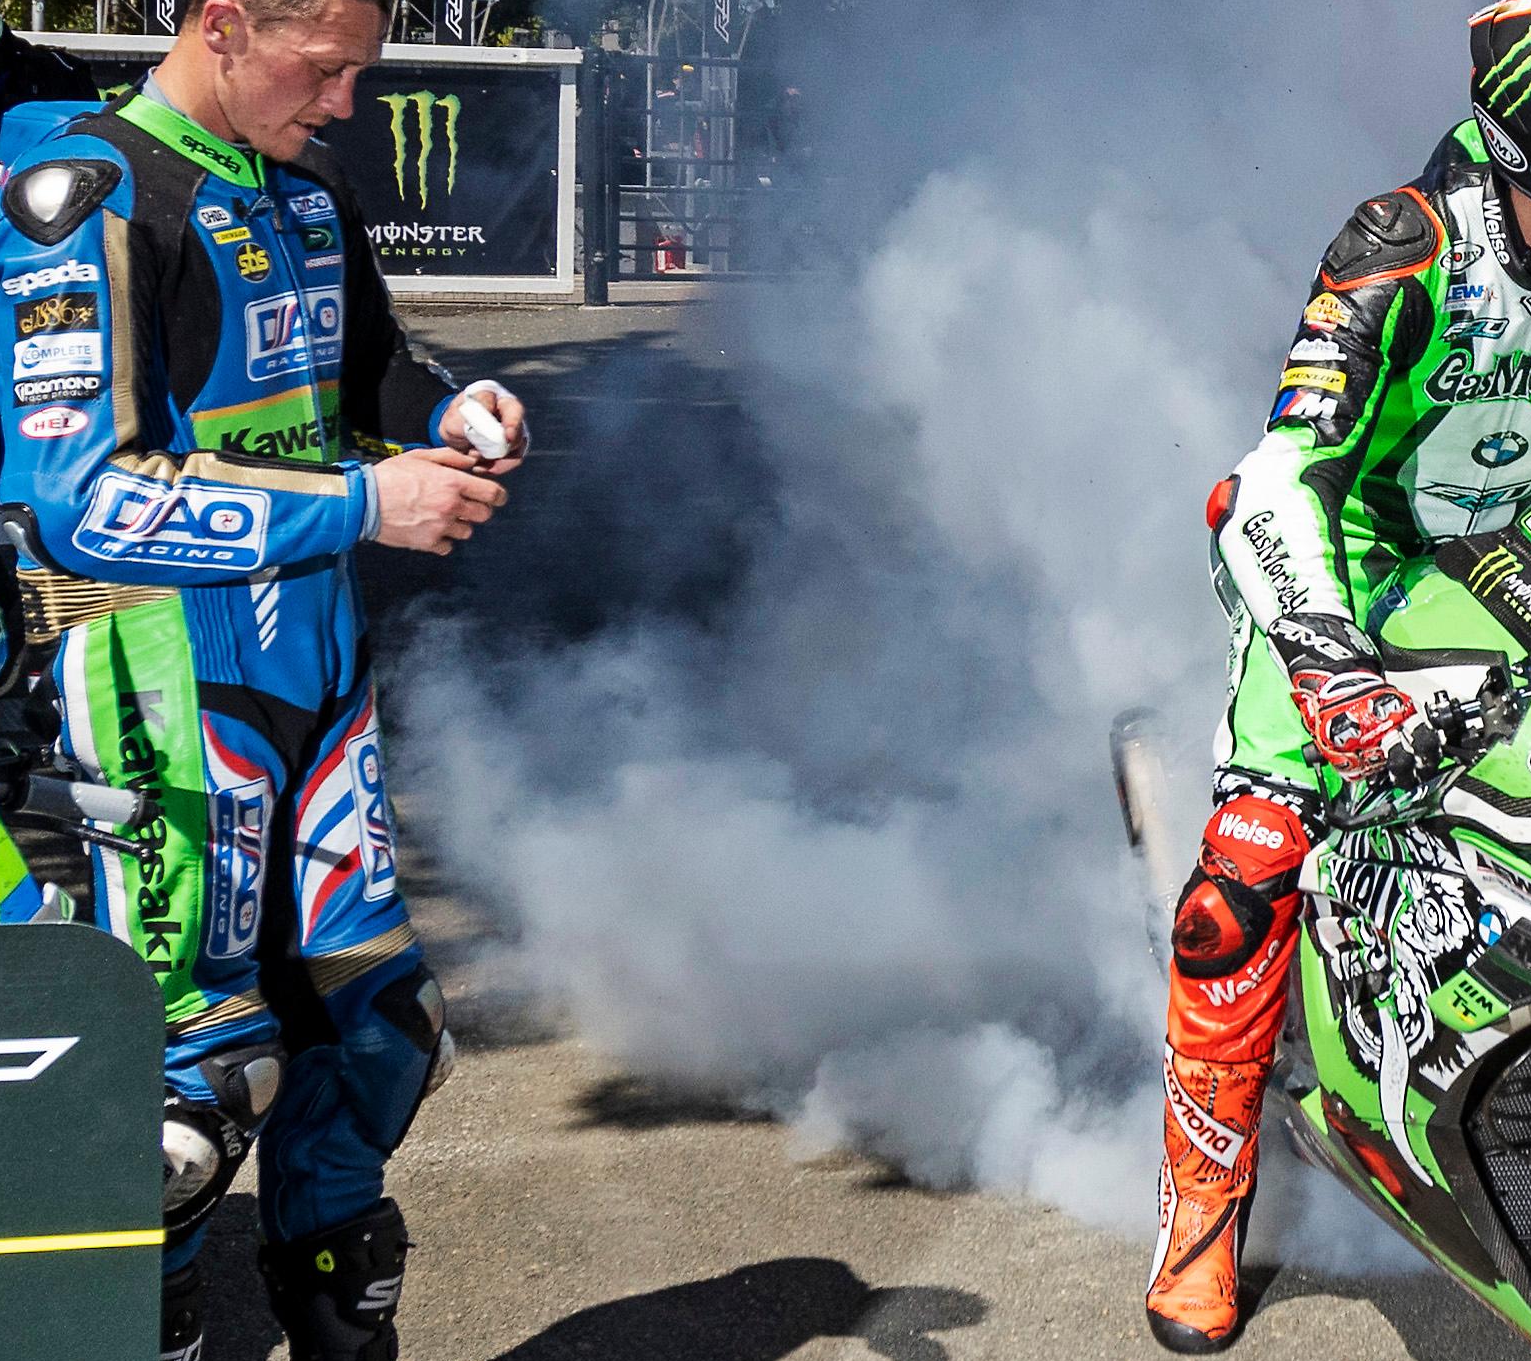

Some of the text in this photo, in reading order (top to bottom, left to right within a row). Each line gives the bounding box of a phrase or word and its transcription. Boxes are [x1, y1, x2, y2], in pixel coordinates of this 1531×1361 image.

[181, 133, 243, 176] spada
[363, 220, 486, 246] MONSTER
[1483, 196, 1511, 265] Weise
[236, 250, 271, 277] sbs
[381, 247, 467, 257] ENERGY
[0, 258, 101, 297] spada
[21, 342, 92, 370] COMPLETE
[25, 376, 100, 395] DIAMOND
[34, 416, 75, 431] HEL
[102, 494, 254, 541] DAO
[102, 537, 236, 562] RACING
[117, 688, 183, 986] Kawasaki
[1216, 810, 1285, 850] Weise
[213, 811, 232, 947] RACING
[1199, 938, 1282, 1007] Weise
